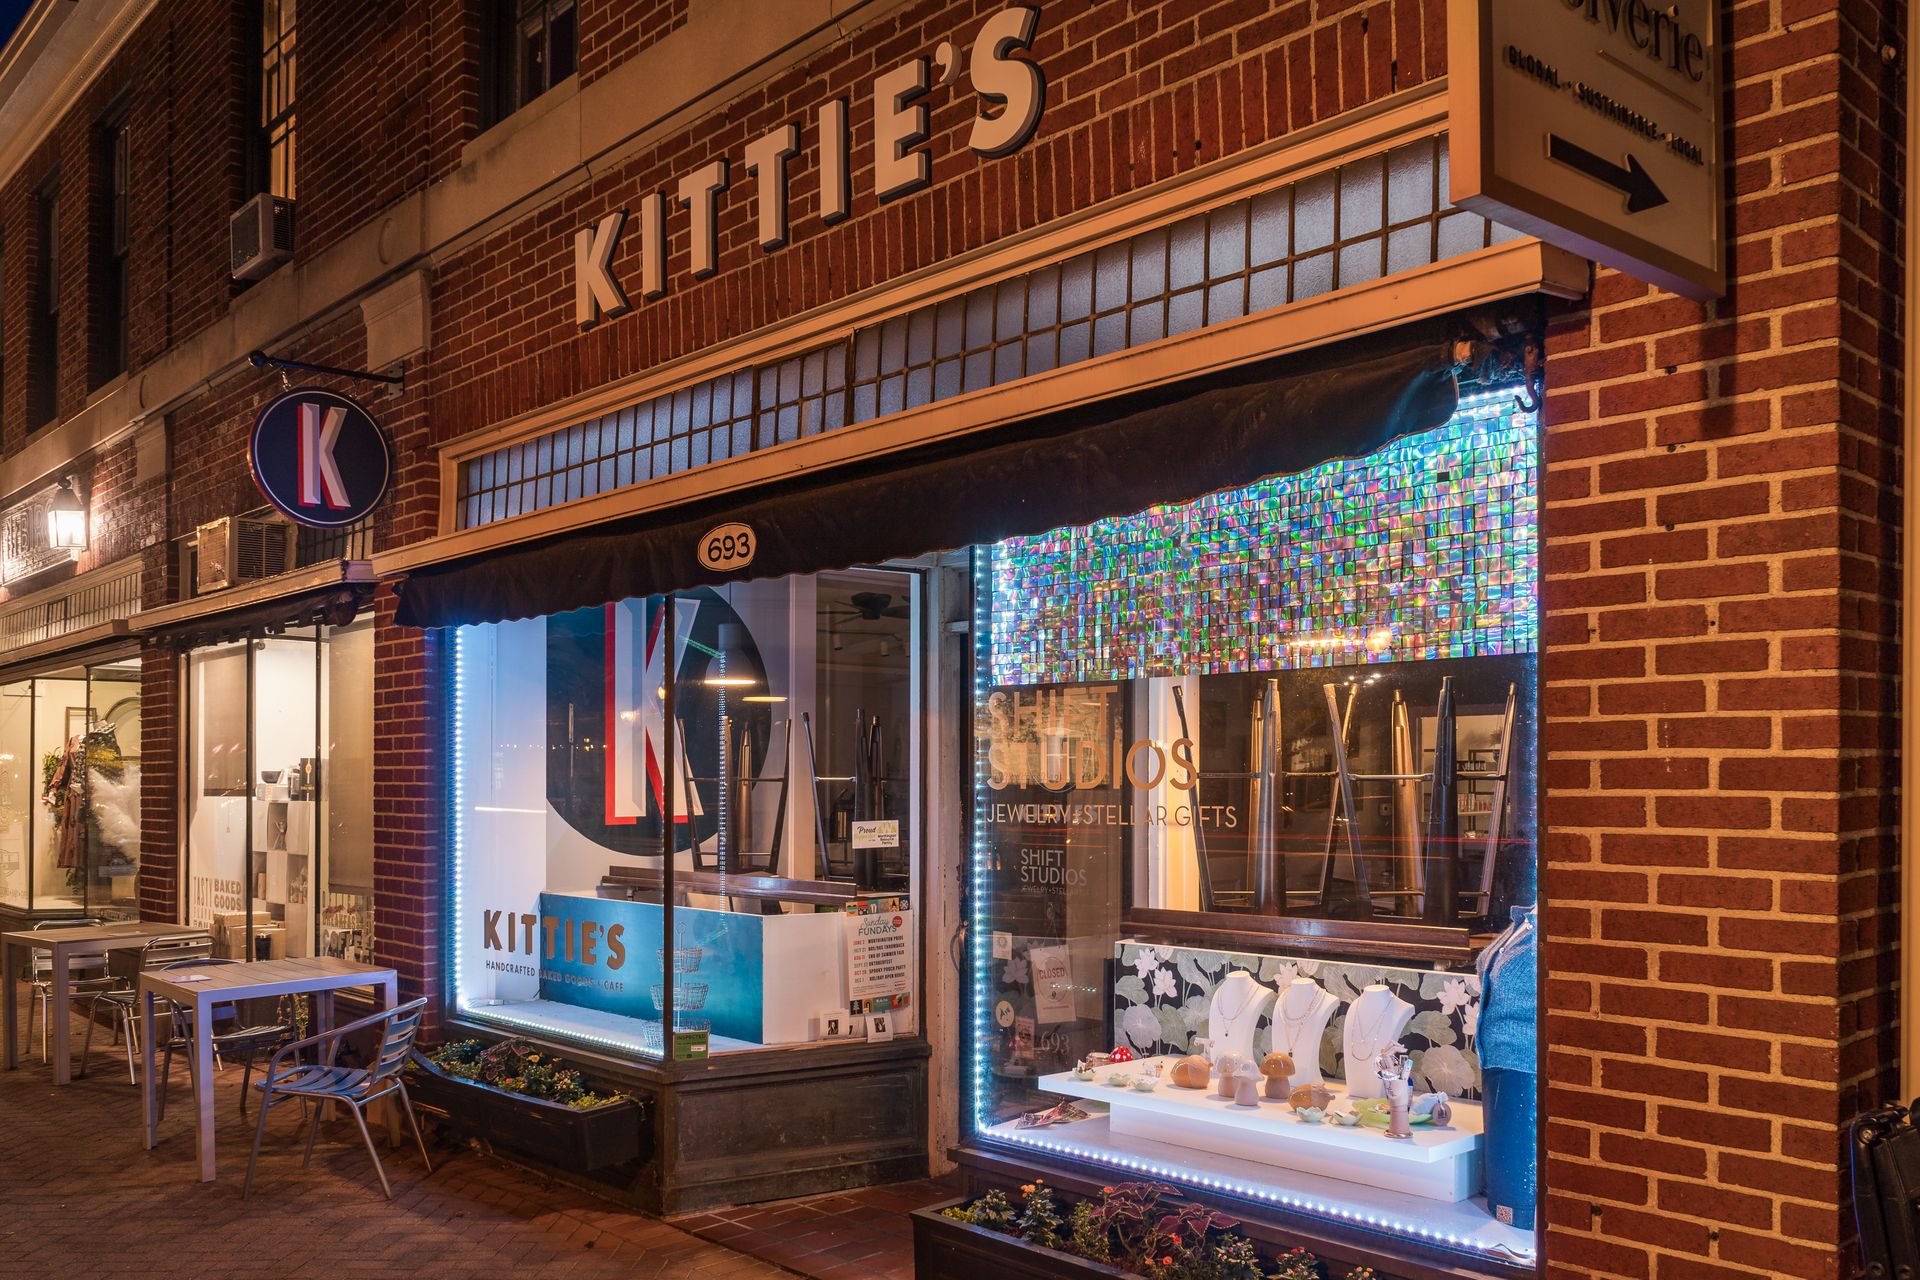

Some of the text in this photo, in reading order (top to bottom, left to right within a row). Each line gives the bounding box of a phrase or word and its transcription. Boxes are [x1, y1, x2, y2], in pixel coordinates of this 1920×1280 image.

[1506, 45, 1560, 89] GLOBAL
[1574, 81, 1657, 140] SUSTAINABLE
[575, 6, 1045, 330] KITTIE'S
[297, 402, 351, 510] K
[708, 532, 750, 562] 693
[987, 686, 1118, 737] SHIFT
[987, 738, 1197, 791] STUDIOS
[1174, 805, 1237, 828] GIFTS
[1020, 849, 1064, 867] SHIFT
[214, 879, 242, 895] BAKED
[1020, 866, 1087, 886] STUDIOS
[214, 894, 242, 911] GOODS
[484, 909, 626, 970] KITTIE'S
[858, 924, 897, 936] FUNDAYS
[485, 960, 536, 977] HANDCRAFTED
[539, 968, 562, 982] BAKED
[564, 973, 593, 987] GOODS
[1039, 968, 1065, 979] CLOSED
[1040, 1031, 1070, 1055] 693
